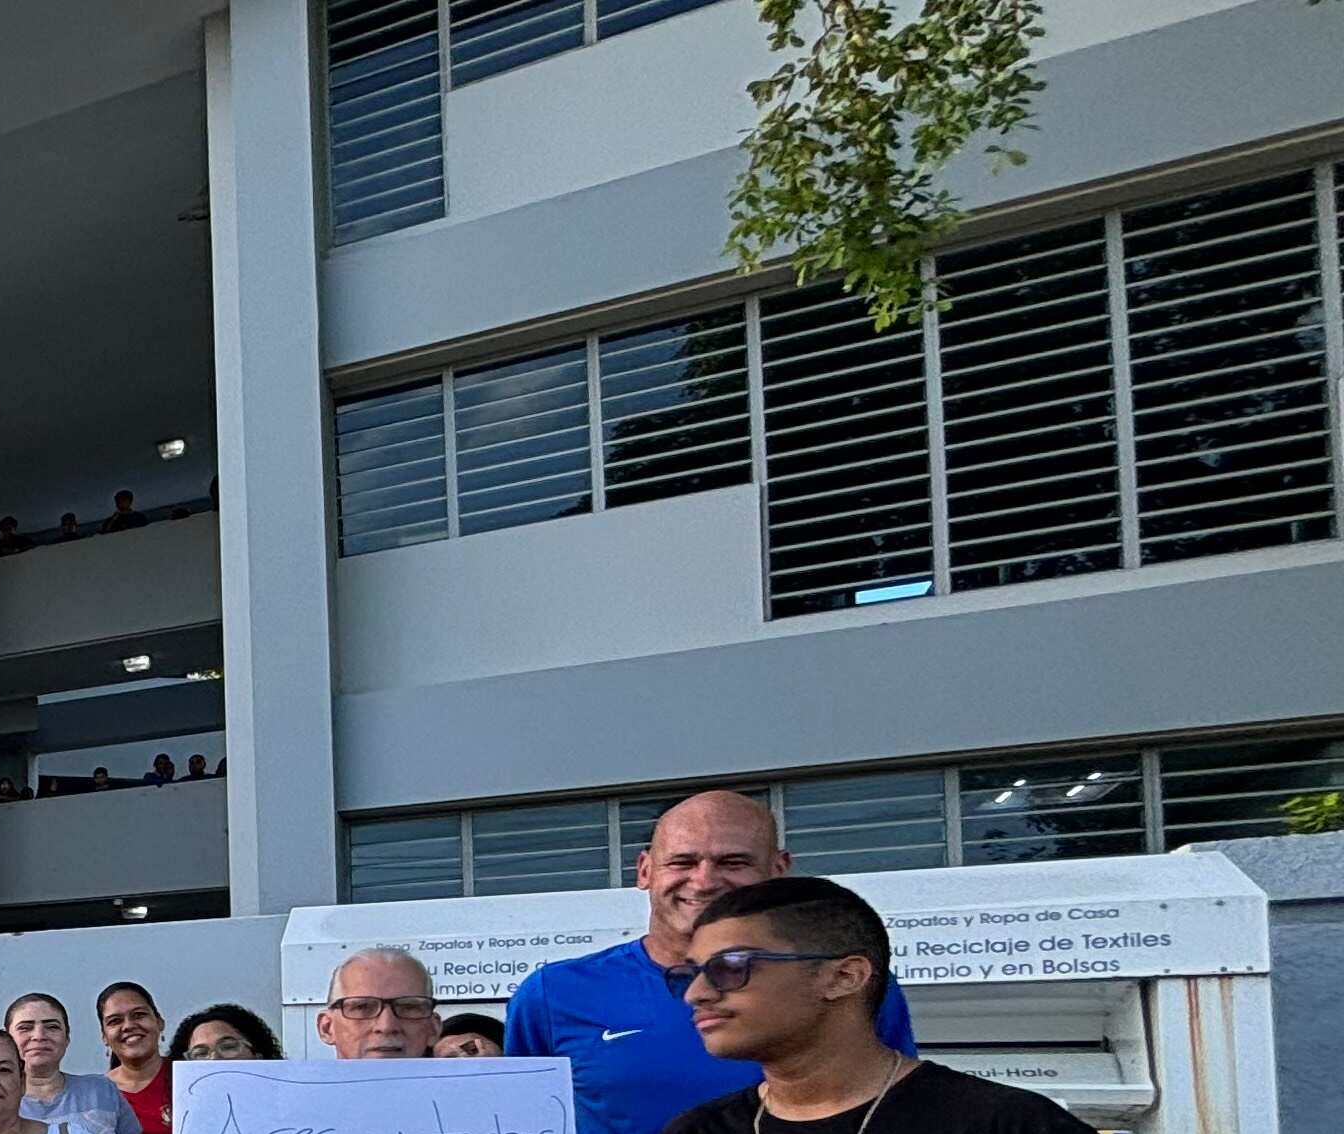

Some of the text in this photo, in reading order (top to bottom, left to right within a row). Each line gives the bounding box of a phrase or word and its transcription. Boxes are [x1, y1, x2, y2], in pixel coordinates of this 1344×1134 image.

[886, 907, 1120, 929] Zapatos y Ropa de Casa
[419, 933, 593, 952] Zapatos y Ropa de Casa
[915, 937, 1031, 957] Reciclaje
[1039, 936, 1074, 952] de
[1082, 932, 1172, 951] Textiles
[443, 960, 529, 977] Reciclaje
[893, 957, 1121, 981] Limpio y en Bolsas
[434, 982, 485, 996] impio
[490, 984, 501, 997] y
